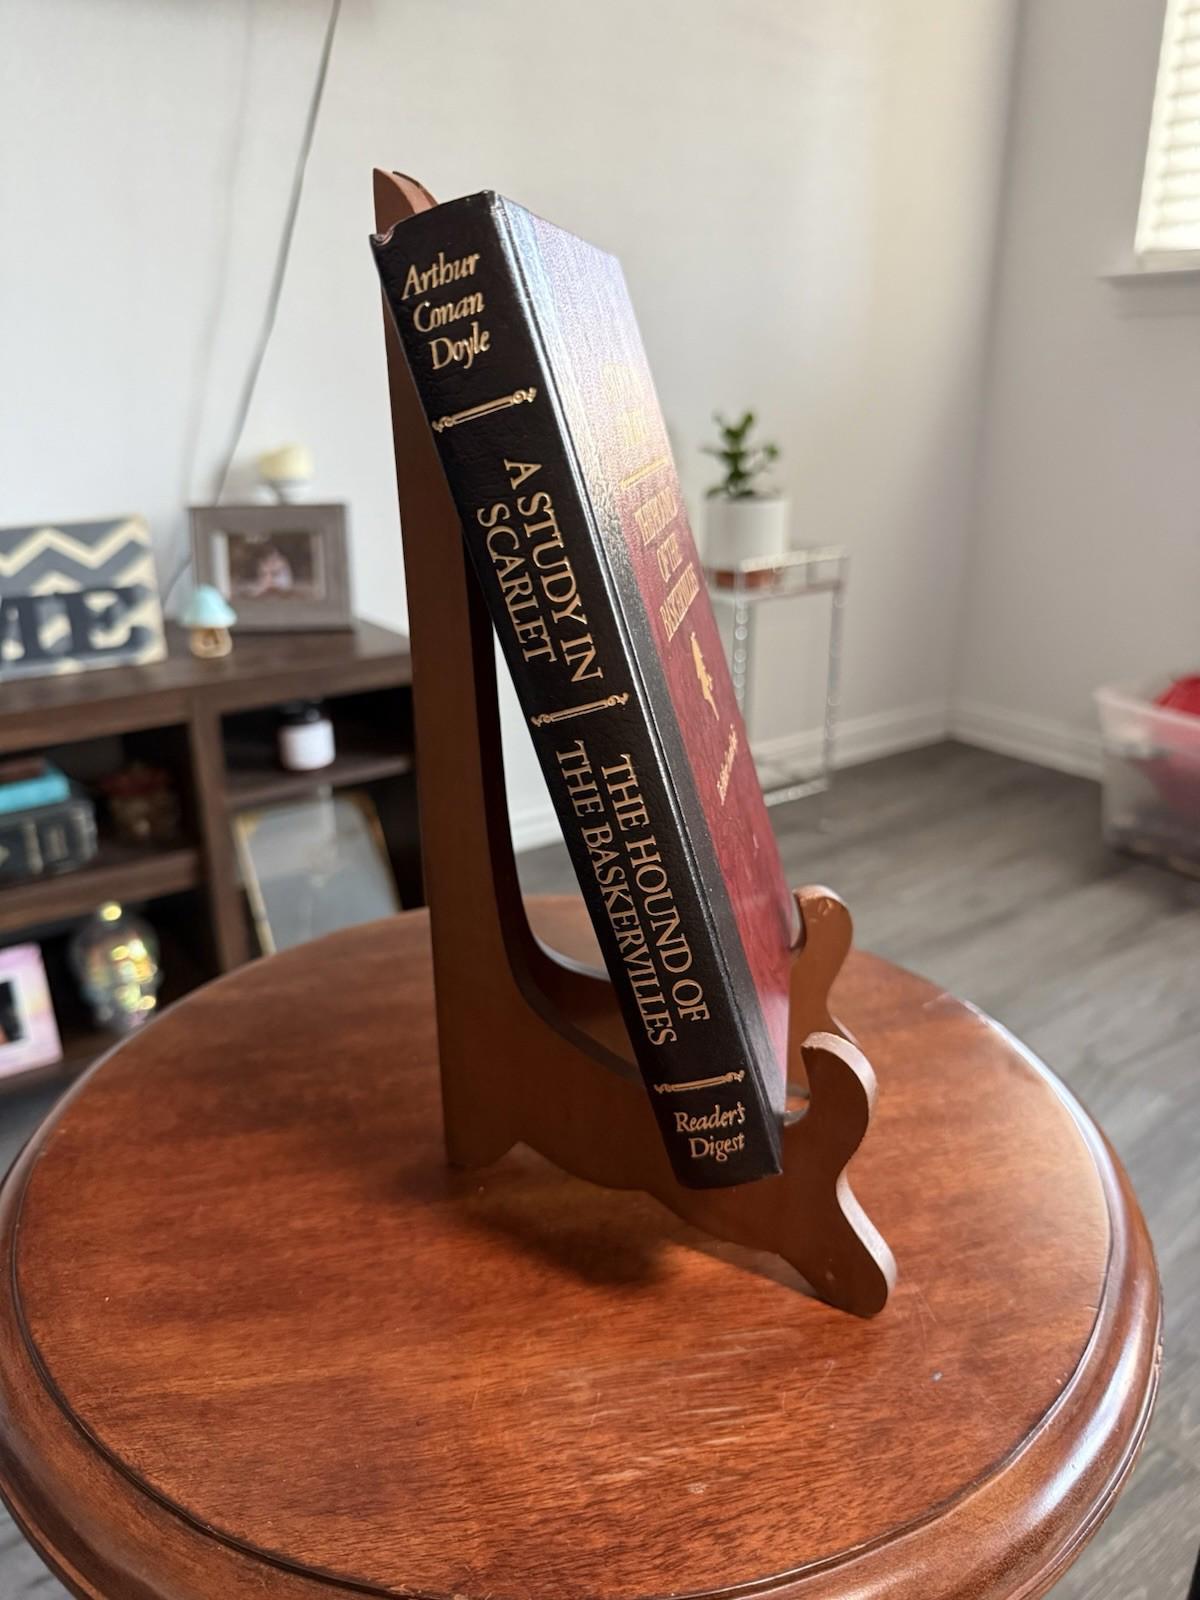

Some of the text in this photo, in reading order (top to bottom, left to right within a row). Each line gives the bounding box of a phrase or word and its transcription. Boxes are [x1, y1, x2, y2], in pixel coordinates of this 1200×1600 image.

[402, 252, 480, 300] Arthur
[413, 292, 485, 332] Conan
[429, 322, 490, 370] Doyle
[476, 503, 557, 662] SCARLET
[503, 458, 604, 683] A STUDY IN
[555, 739, 677, 1045] THE BASKERVILLES
[601, 753, 710, 1022] THE HOUND OF
[674, 1101, 746, 1133] Reader's
[688, 1132, 745, 1162] Digest
